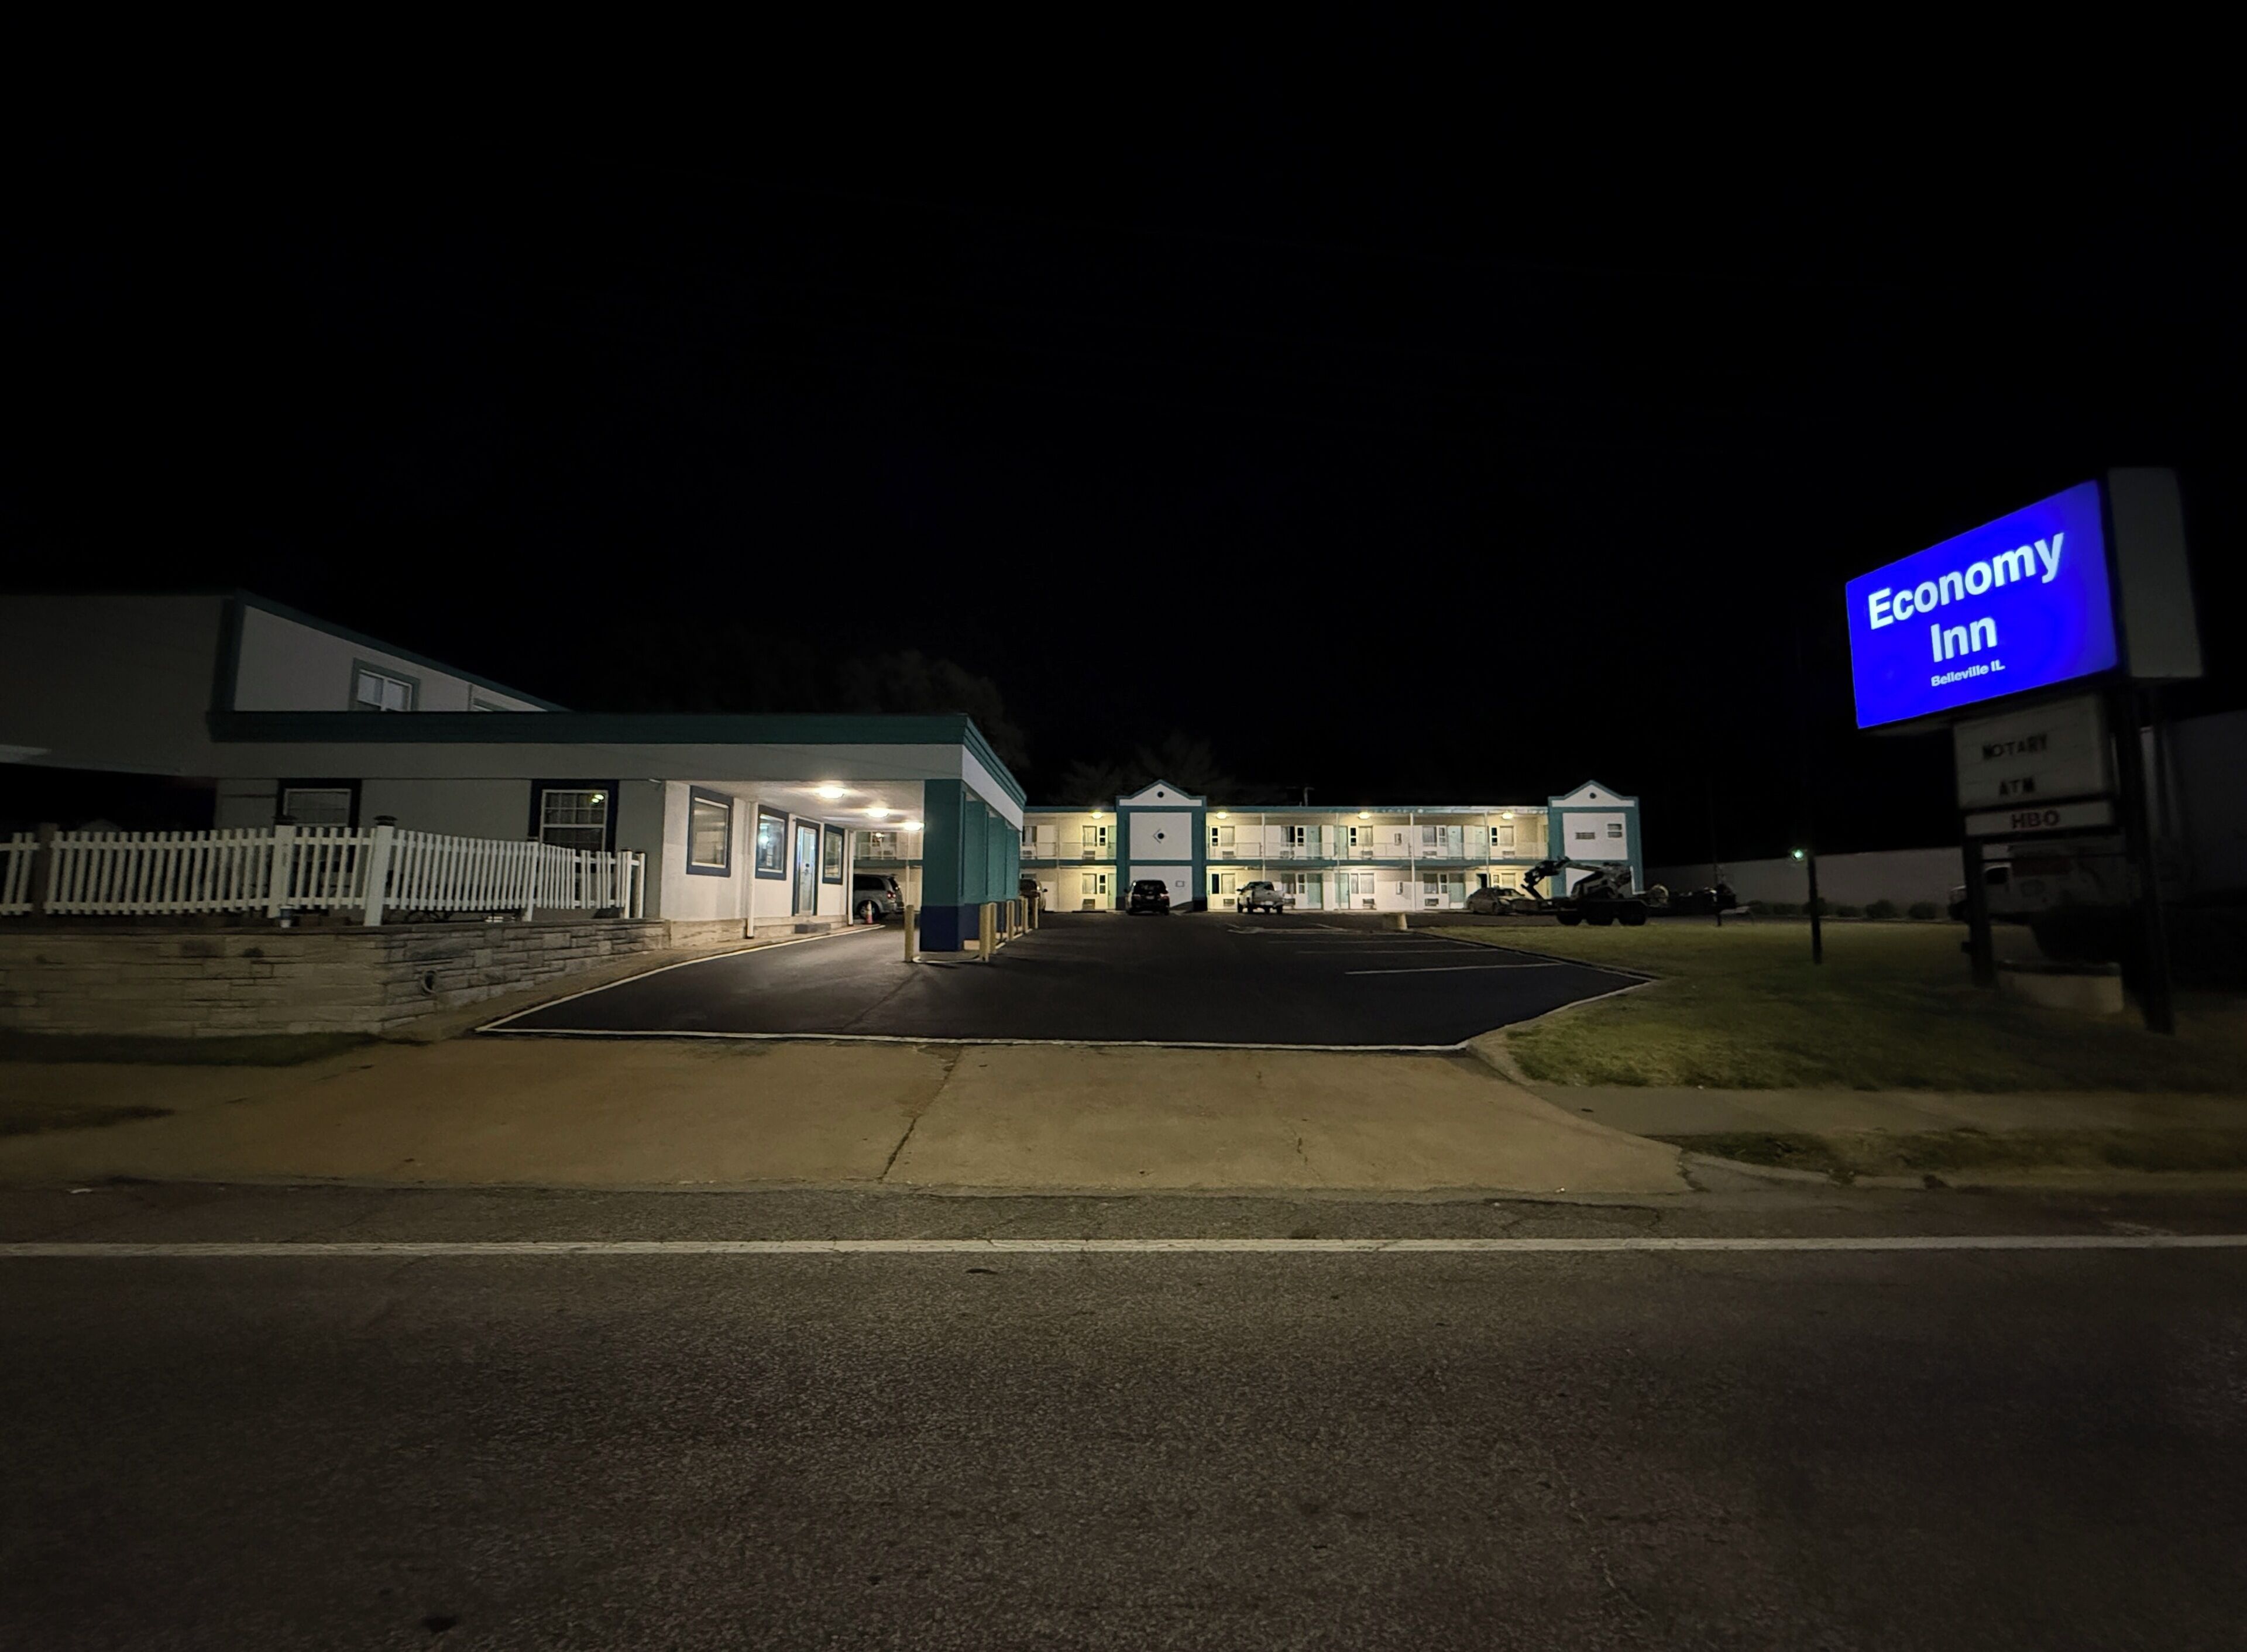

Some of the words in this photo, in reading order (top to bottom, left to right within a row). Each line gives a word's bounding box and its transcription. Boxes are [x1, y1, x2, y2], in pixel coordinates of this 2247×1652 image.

[1868, 532, 2064, 630] Economy
[1930, 616, 1998, 663] Inn
[1931, 664, 1990, 687] Belleville
[1990, 659, 2006, 672] IL
[1983, 734, 2047, 760] NOTARY
[1999, 777, 2034, 795] ATM
[2012, 810, 2059, 829] HBO
